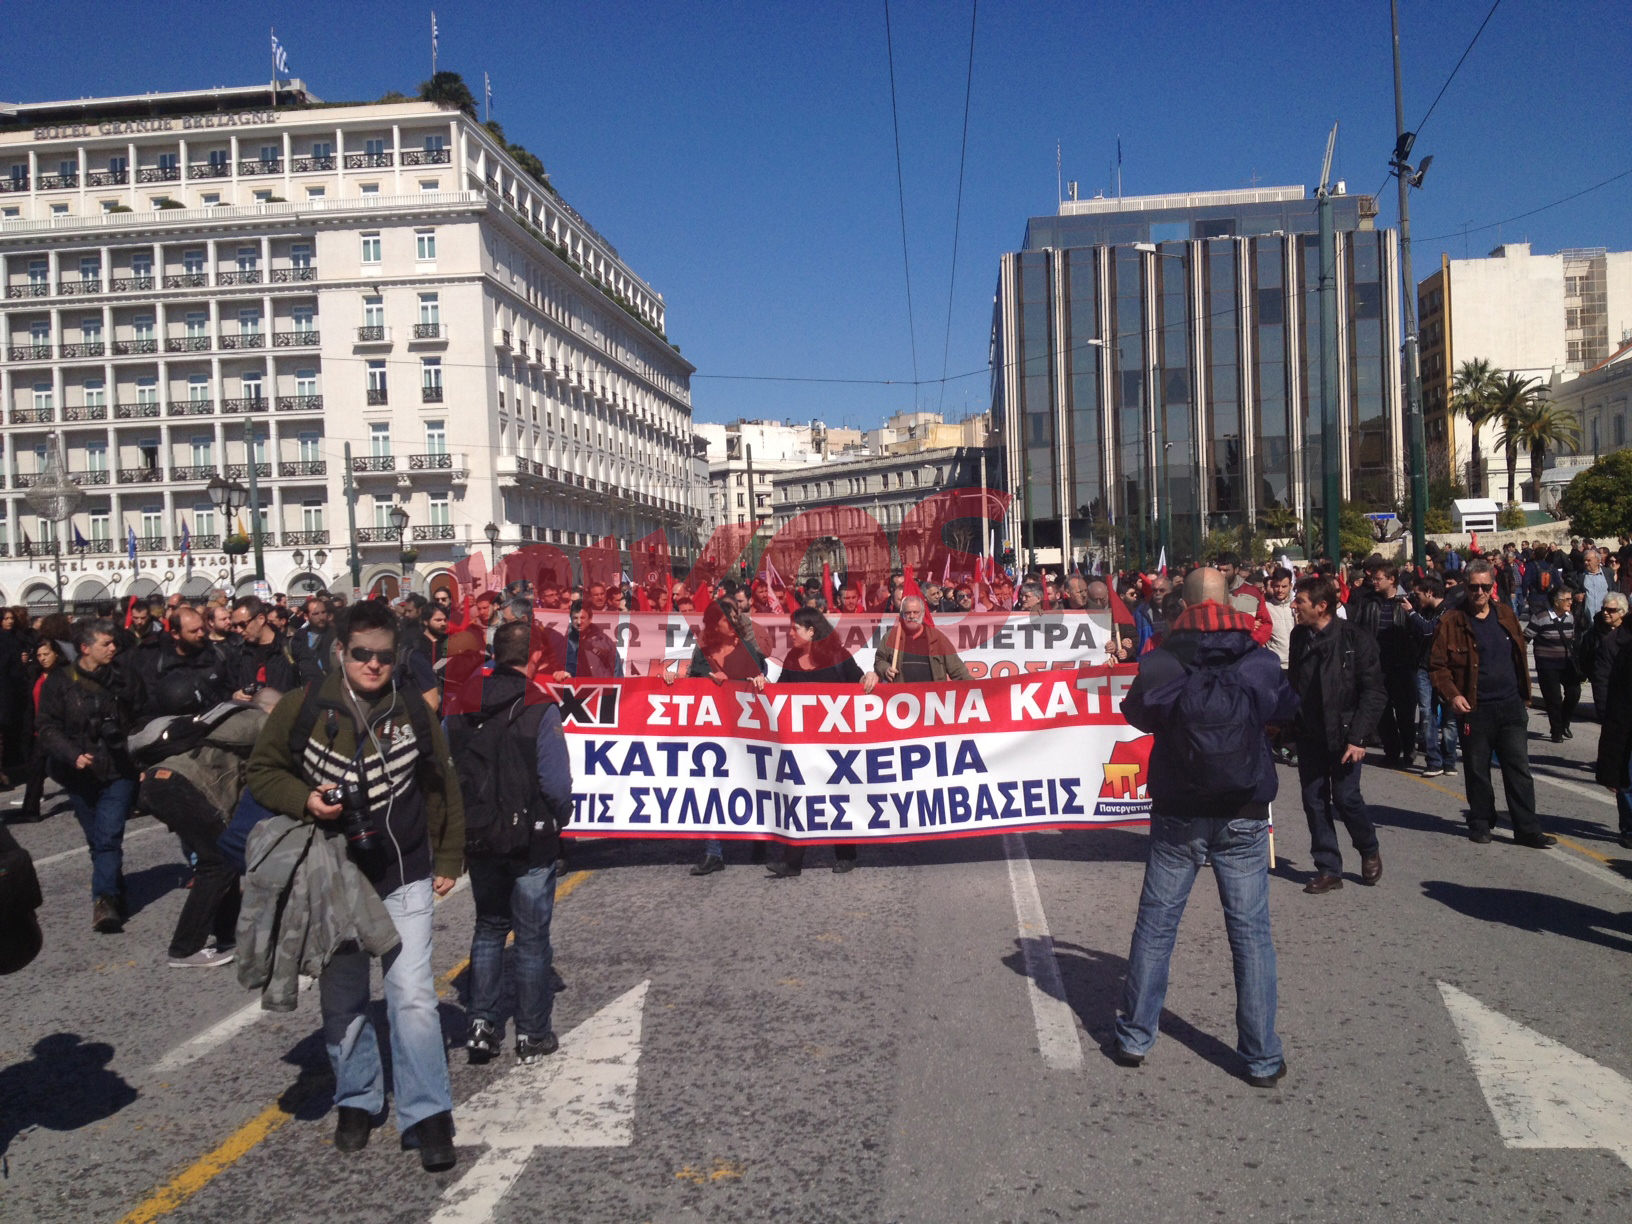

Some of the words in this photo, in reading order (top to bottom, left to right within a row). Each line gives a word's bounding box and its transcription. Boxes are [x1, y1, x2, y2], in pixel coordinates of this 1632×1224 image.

[33, 124, 90, 140] HOTEL
[99, 118, 173, 135] GRANDE
[182, 110, 276, 129] BRETAGNE
[39, 561, 87, 572] HOTEL
[96, 559, 157, 570] GRANDE
[958, 623, 1097, 650] ΜΕΤΡΑ
[546, 683, 621, 728] ΧΙ
[646, 694, 722, 726] ΣΤΑ
[735, 688, 991, 733] ΣΥΓΧΡΟΝΑ
[1010, 675, 1137, 721] ΚΑΤΕ
[584, 739, 729, 778] ΚΑΤΩ
[746, 744, 806, 786] ΤΑ
[826, 739, 988, 785] ΧΕΡΙΑ
[571, 793, 614, 824] ΤΙΣ
[629, 787, 853, 832] ΣΥΛΛΟΓΙΚΕΣ
[867, 778, 1085, 830] ΣΥΜΒΑΣΕΙΣ
